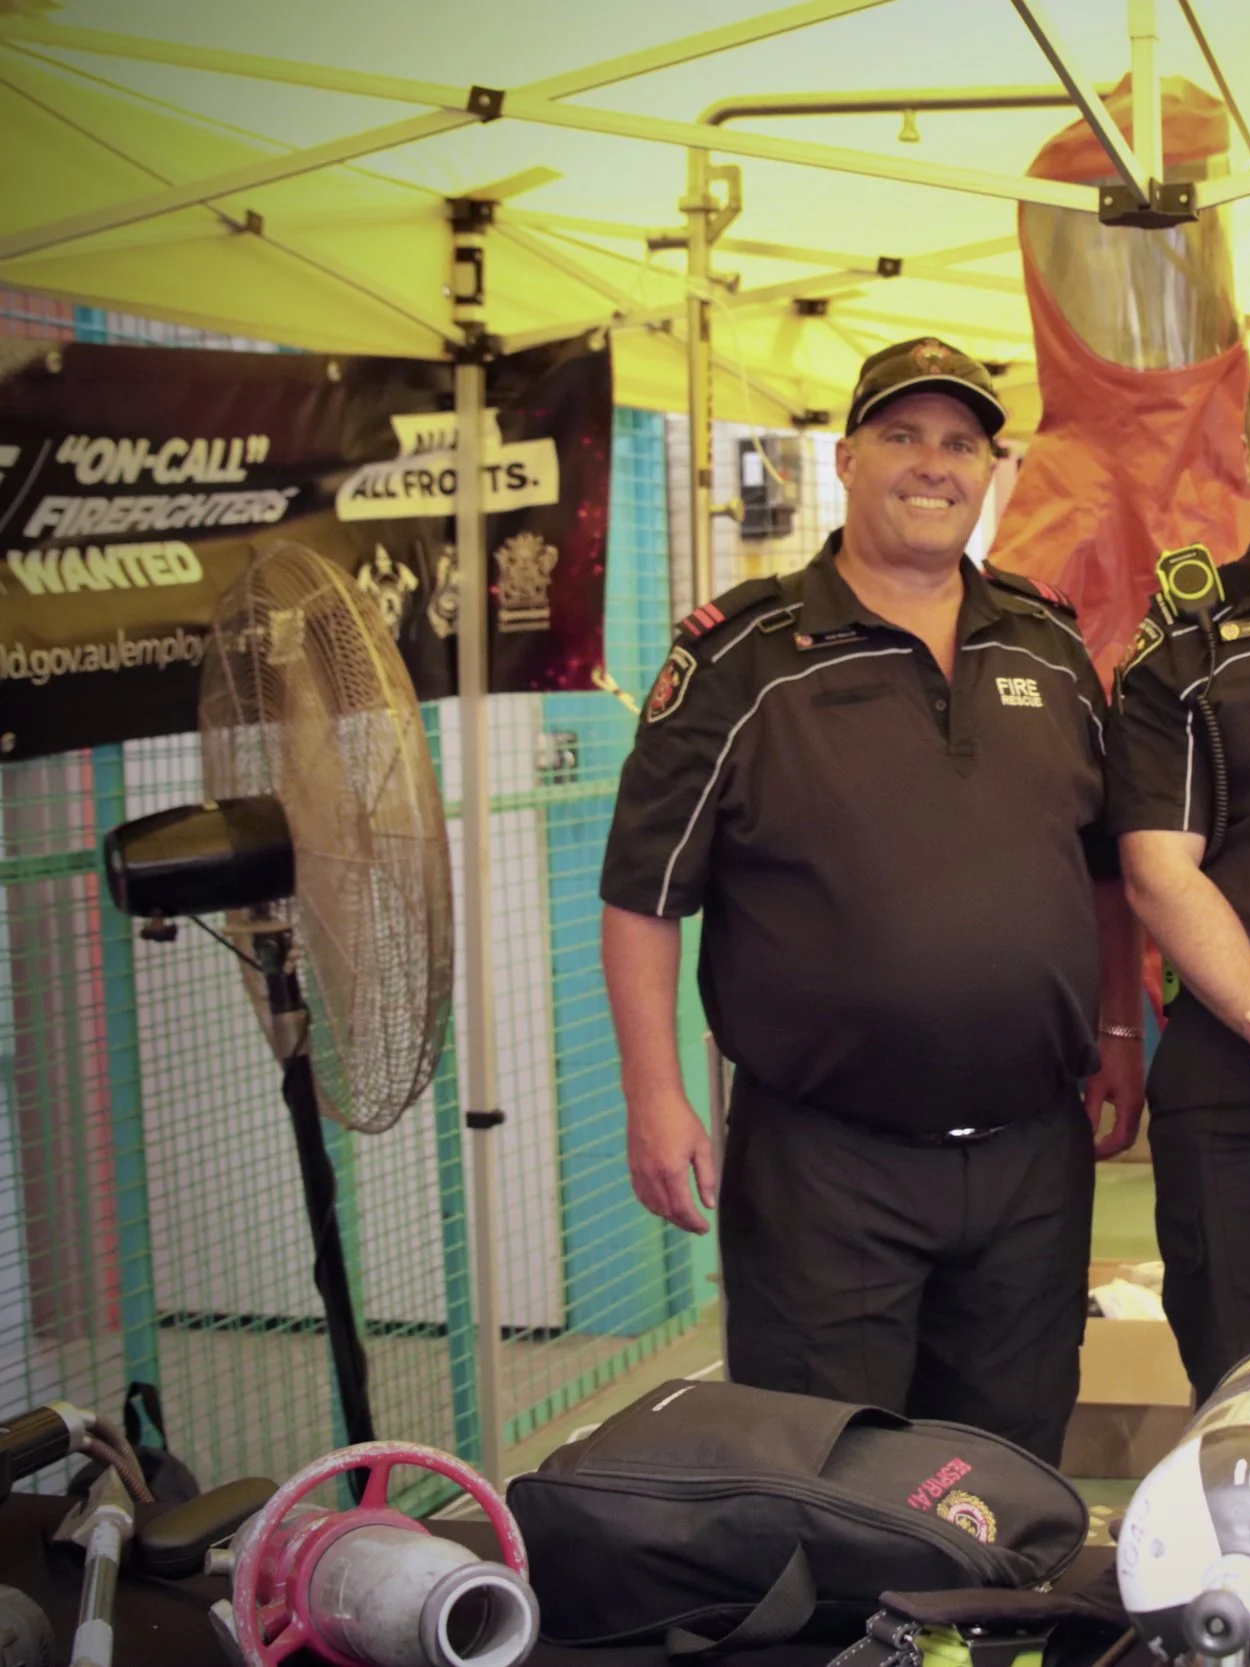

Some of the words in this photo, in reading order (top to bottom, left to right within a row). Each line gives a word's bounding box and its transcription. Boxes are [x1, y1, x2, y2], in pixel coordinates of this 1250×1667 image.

[352, 468, 397, 501] ALL
[403, 462, 539, 499] FROTS.
[7, 540, 204, 595] WANTED
[995, 677, 1041, 696] FIRE
[1001, 694, 1044, 708] RESCUE
